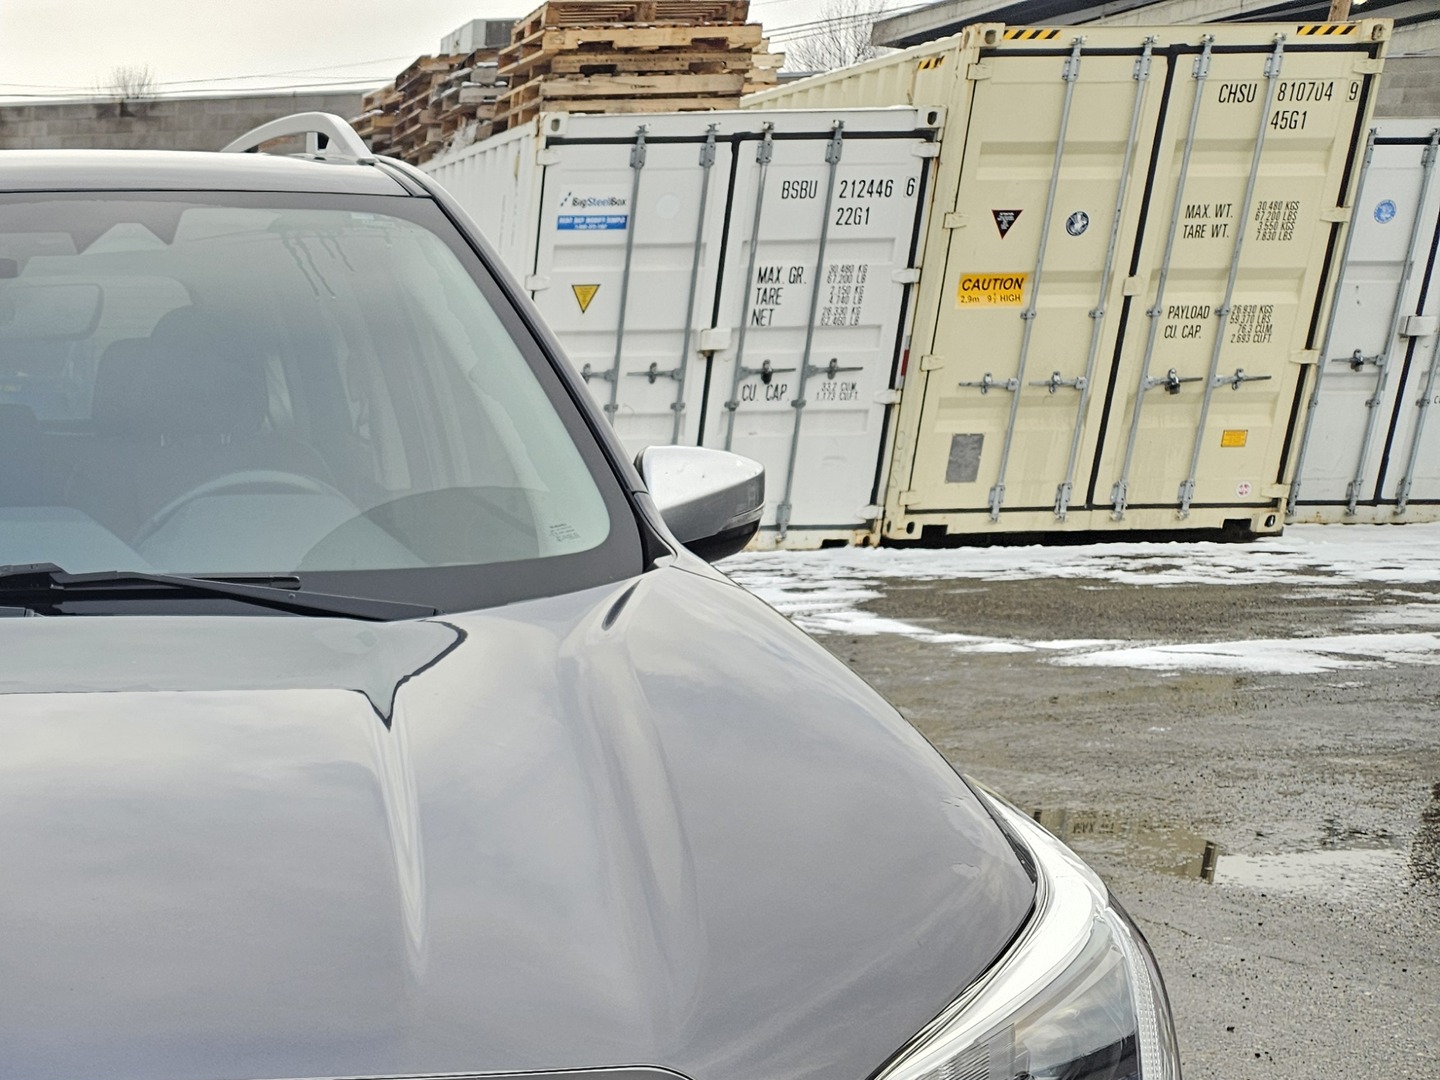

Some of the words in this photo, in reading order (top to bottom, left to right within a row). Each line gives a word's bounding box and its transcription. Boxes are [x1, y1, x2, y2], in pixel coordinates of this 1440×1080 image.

[1218, 83, 1258, 103] CHSU
[1277, 81, 1334, 102] 810704
[1348, 80, 1360, 101] 9
[1270, 110, 1308, 130] 45G1
[781, 180, 818, 200] BSBU
[839, 179, 894, 199] 212446
[905, 177, 917, 197] 6
[1184, 203, 1211, 219] MAX.
[1214, 203, 1233, 219] WT.
[1285, 201, 1300, 211] KGS
[835, 206, 871, 226] 22G1
[1282, 211, 1298, 221] LBS
[1183, 224, 1207, 239] TARE
[1211, 224, 1230, 239] WT.
[1280, 221, 1295, 231] KGS
[1278, 231, 1293, 241] LBS
[757, 266, 785, 284] MAX.
[788, 266, 807, 284] GR.
[962, 277, 1024, 291] CAUTION
[756, 287, 784, 305] TARE
[999, 294, 1021, 303] HIGH
[1167, 305, 1211, 320] PAYLOAD
[1259, 304, 1274, 314] KGS
[751, 308, 775, 326] NET
[1257, 314, 1272, 324] LBS
[1181, 324, 1202, 339] CAP.
[765, 383, 790, 401] CAP.
